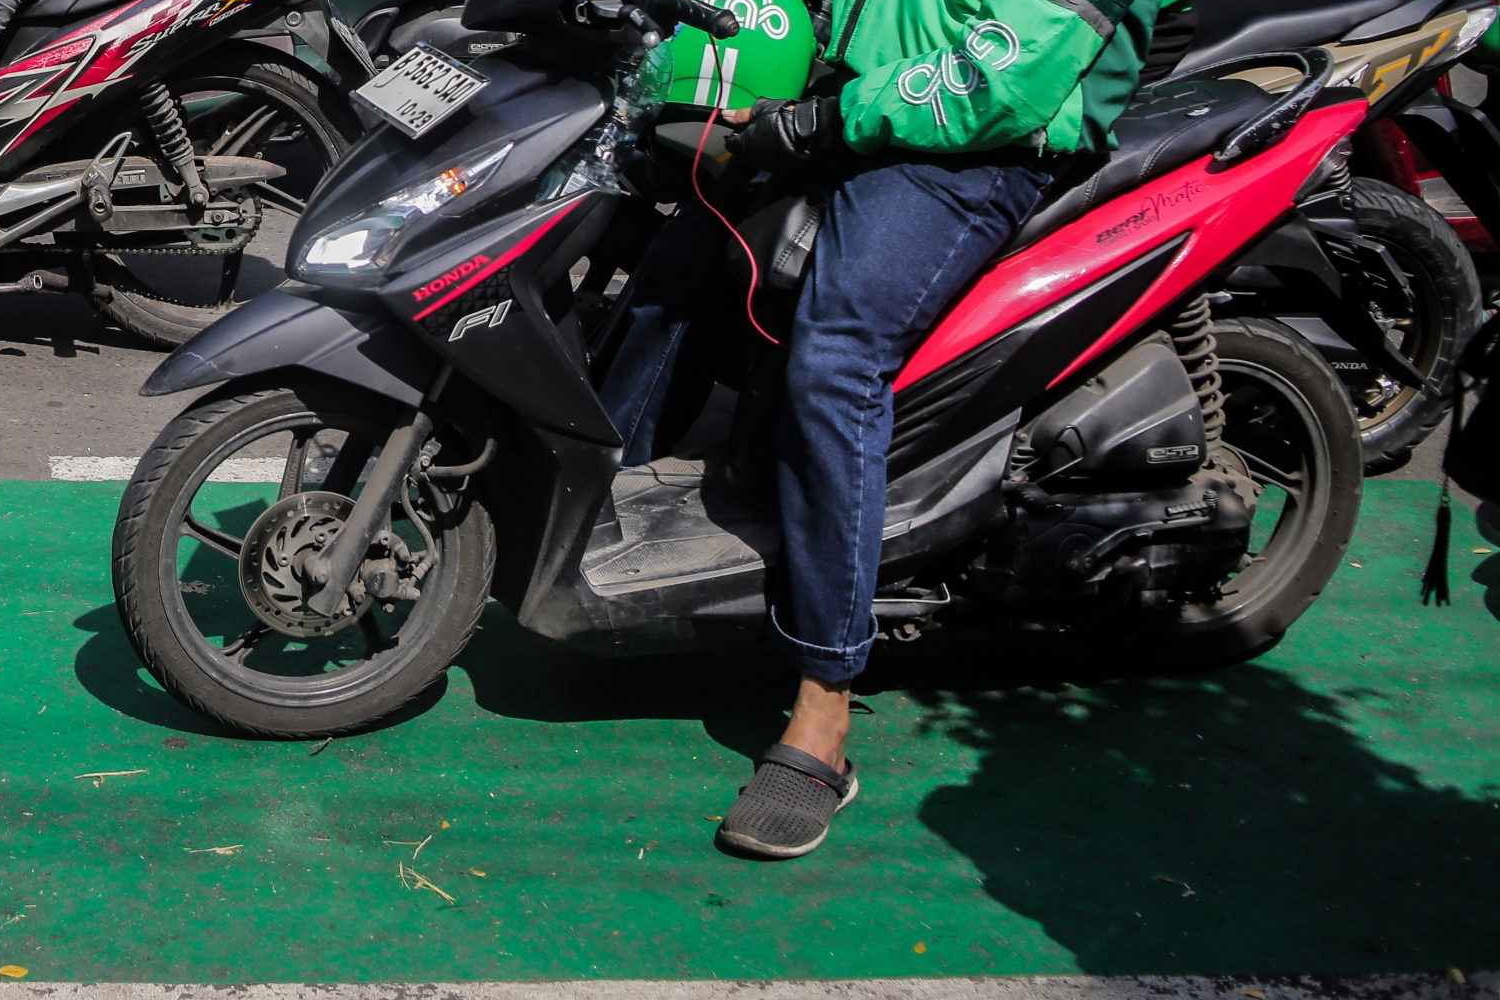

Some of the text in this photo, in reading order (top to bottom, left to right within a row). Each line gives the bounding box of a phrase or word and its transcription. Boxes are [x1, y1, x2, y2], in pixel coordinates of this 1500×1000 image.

[393, 51, 422, 71] B
[404, 55, 452, 89] 5662
[412, 254, 491, 302] HONDA
[447, 299, 513, 342] FI
